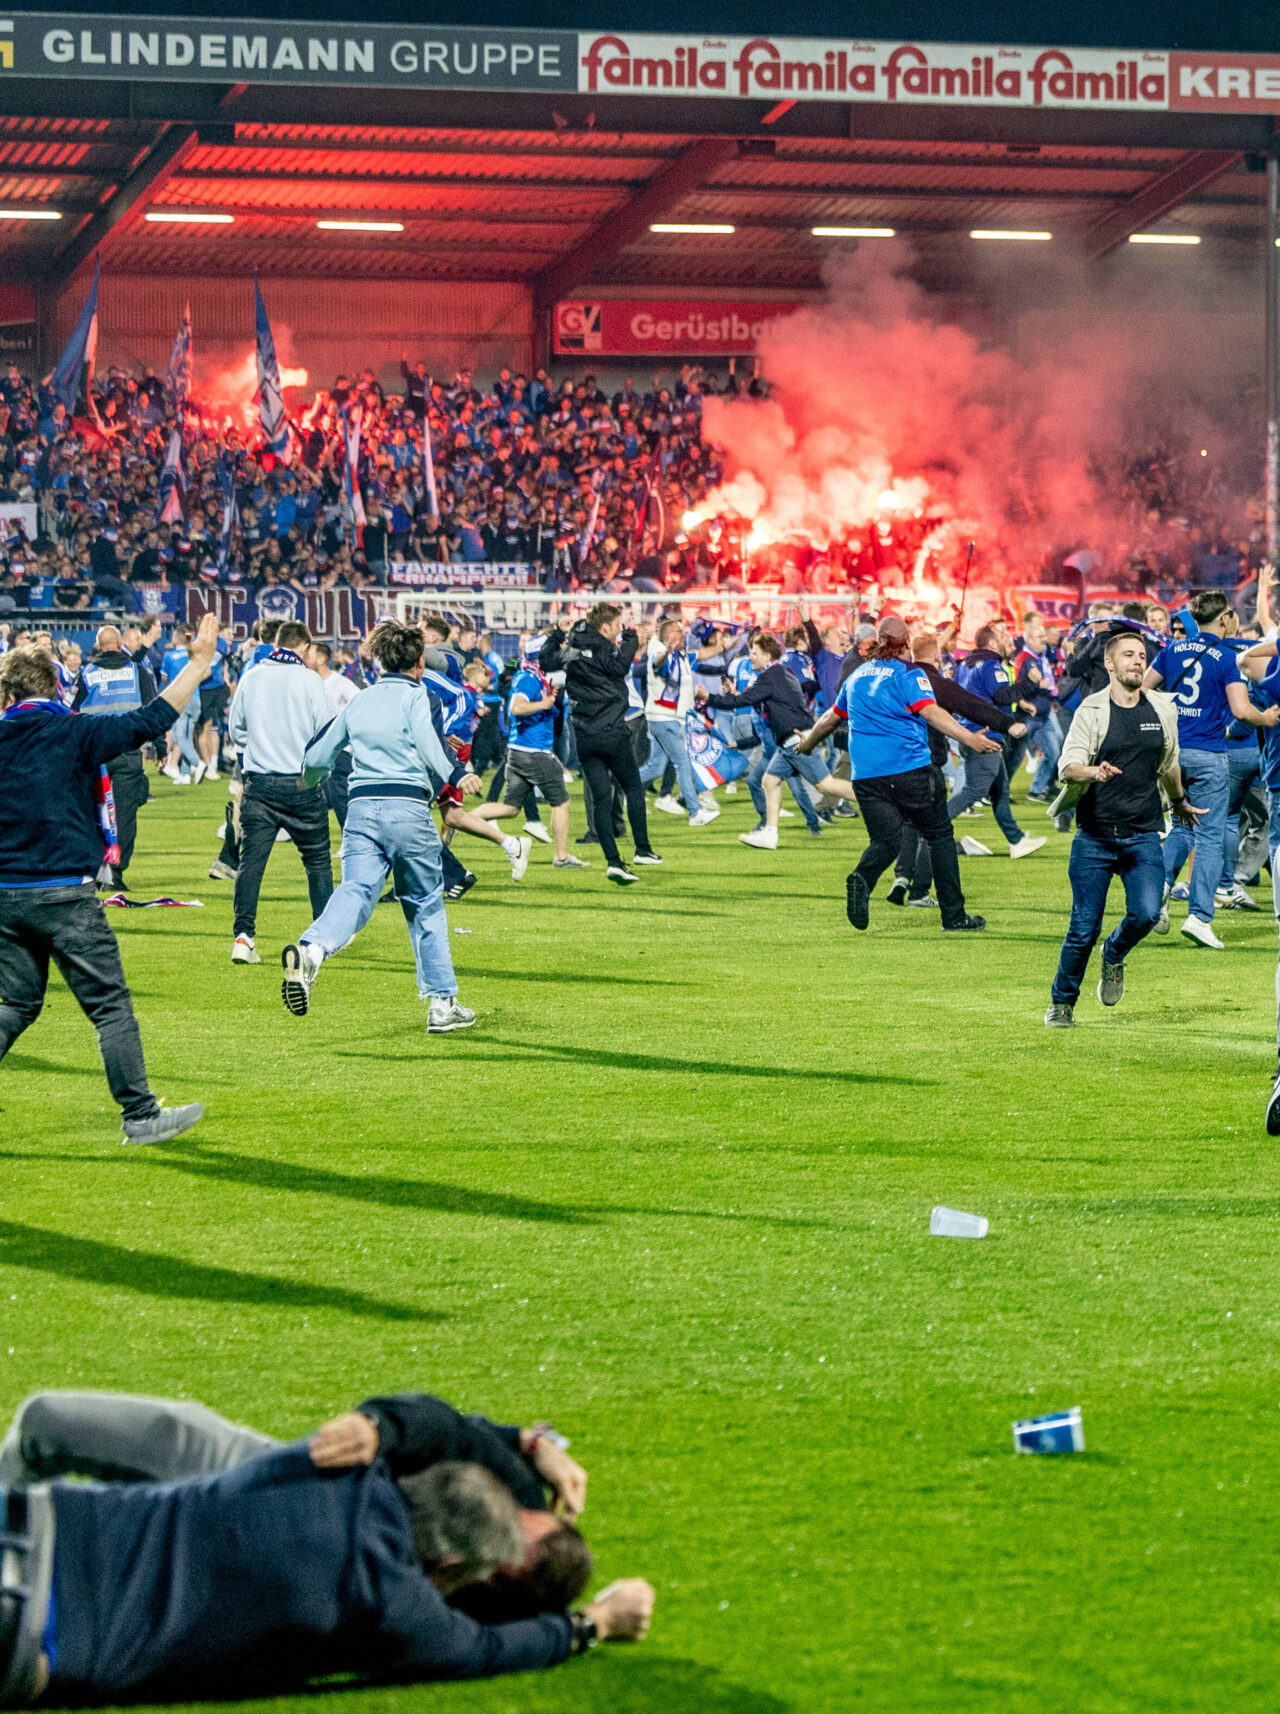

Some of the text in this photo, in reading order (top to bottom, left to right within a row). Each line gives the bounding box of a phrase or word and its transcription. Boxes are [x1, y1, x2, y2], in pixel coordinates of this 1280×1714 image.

[43, 29, 562, 77] GLINDEMANN GRUPPE
[581, 34, 726, 91] famila
[733, 39, 875, 95] famila
[881, 45, 1021, 100] famila
[1027, 50, 1165, 105] famila
[630, 313, 770, 341] Gerüstba
[1206, 647, 1223, 661] KIEL
[1178, 657, 1203, 705] 3
[1178, 706, 1203, 718] CHMIDT
